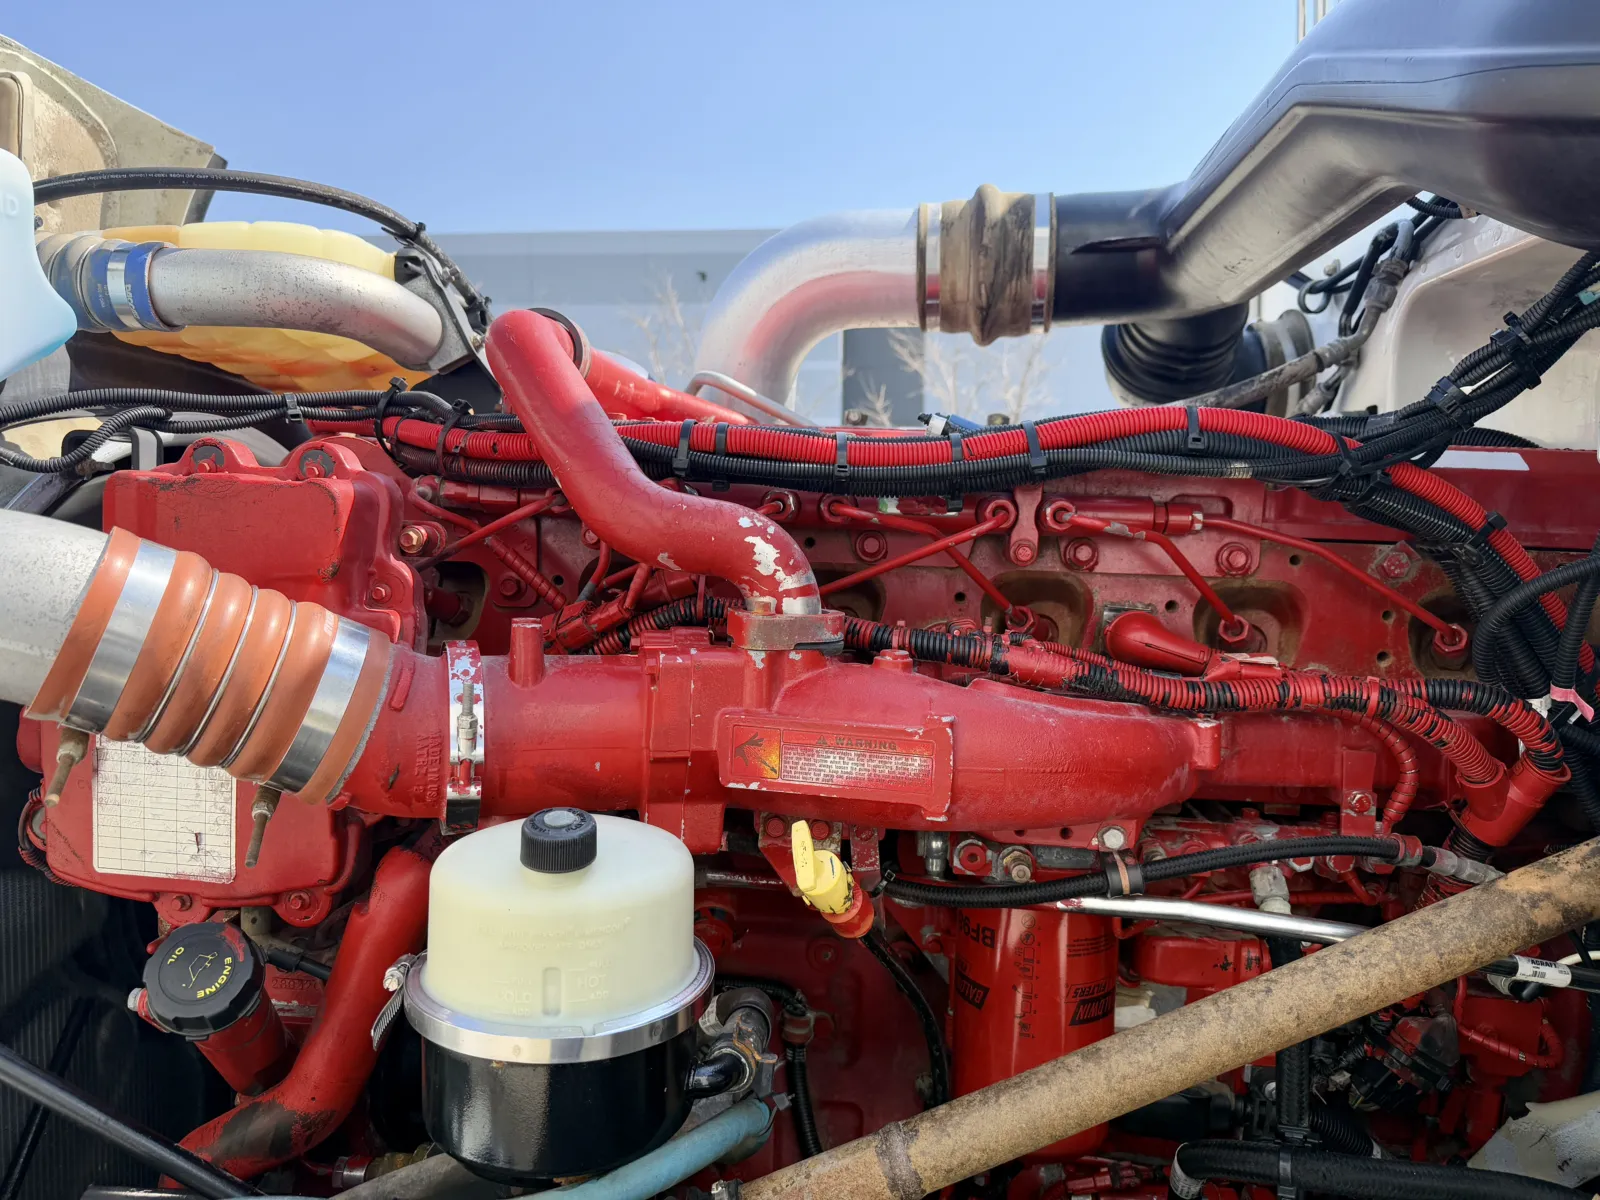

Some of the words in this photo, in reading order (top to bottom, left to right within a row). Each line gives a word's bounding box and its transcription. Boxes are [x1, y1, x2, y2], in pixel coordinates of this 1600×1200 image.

[835, 736, 898, 750] WARNING
[167, 946, 184, 965] OIL
[197, 957, 232, 998] ENGINE
[576, 974, 607, 990] HOT
[1072, 984, 1107, 999] FILTERS
